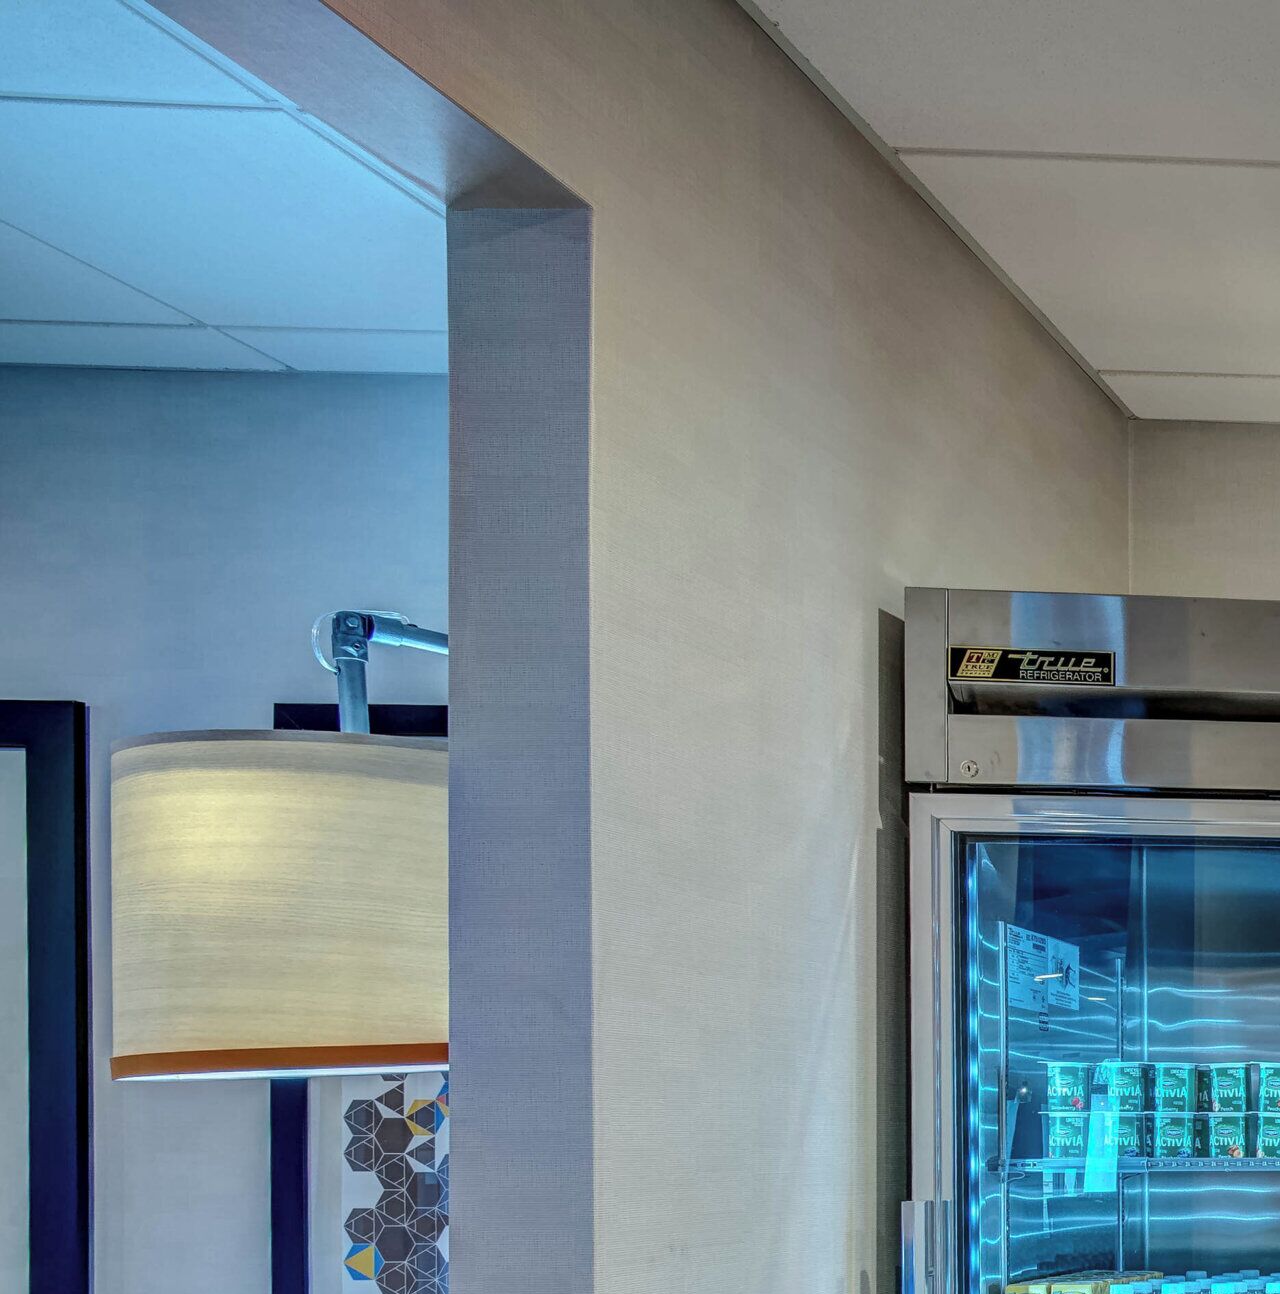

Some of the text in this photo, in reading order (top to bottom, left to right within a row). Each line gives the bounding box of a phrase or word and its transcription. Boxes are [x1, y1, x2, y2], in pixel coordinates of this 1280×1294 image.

[1020, 671, 1102, 682] REFRIGERATOR
[1047, 1085, 1084, 1097] ACTIVIA
[1155, 1135, 1192, 1147] ACTIVIA
[1209, 1135, 1245, 1147] ACTIVIA
